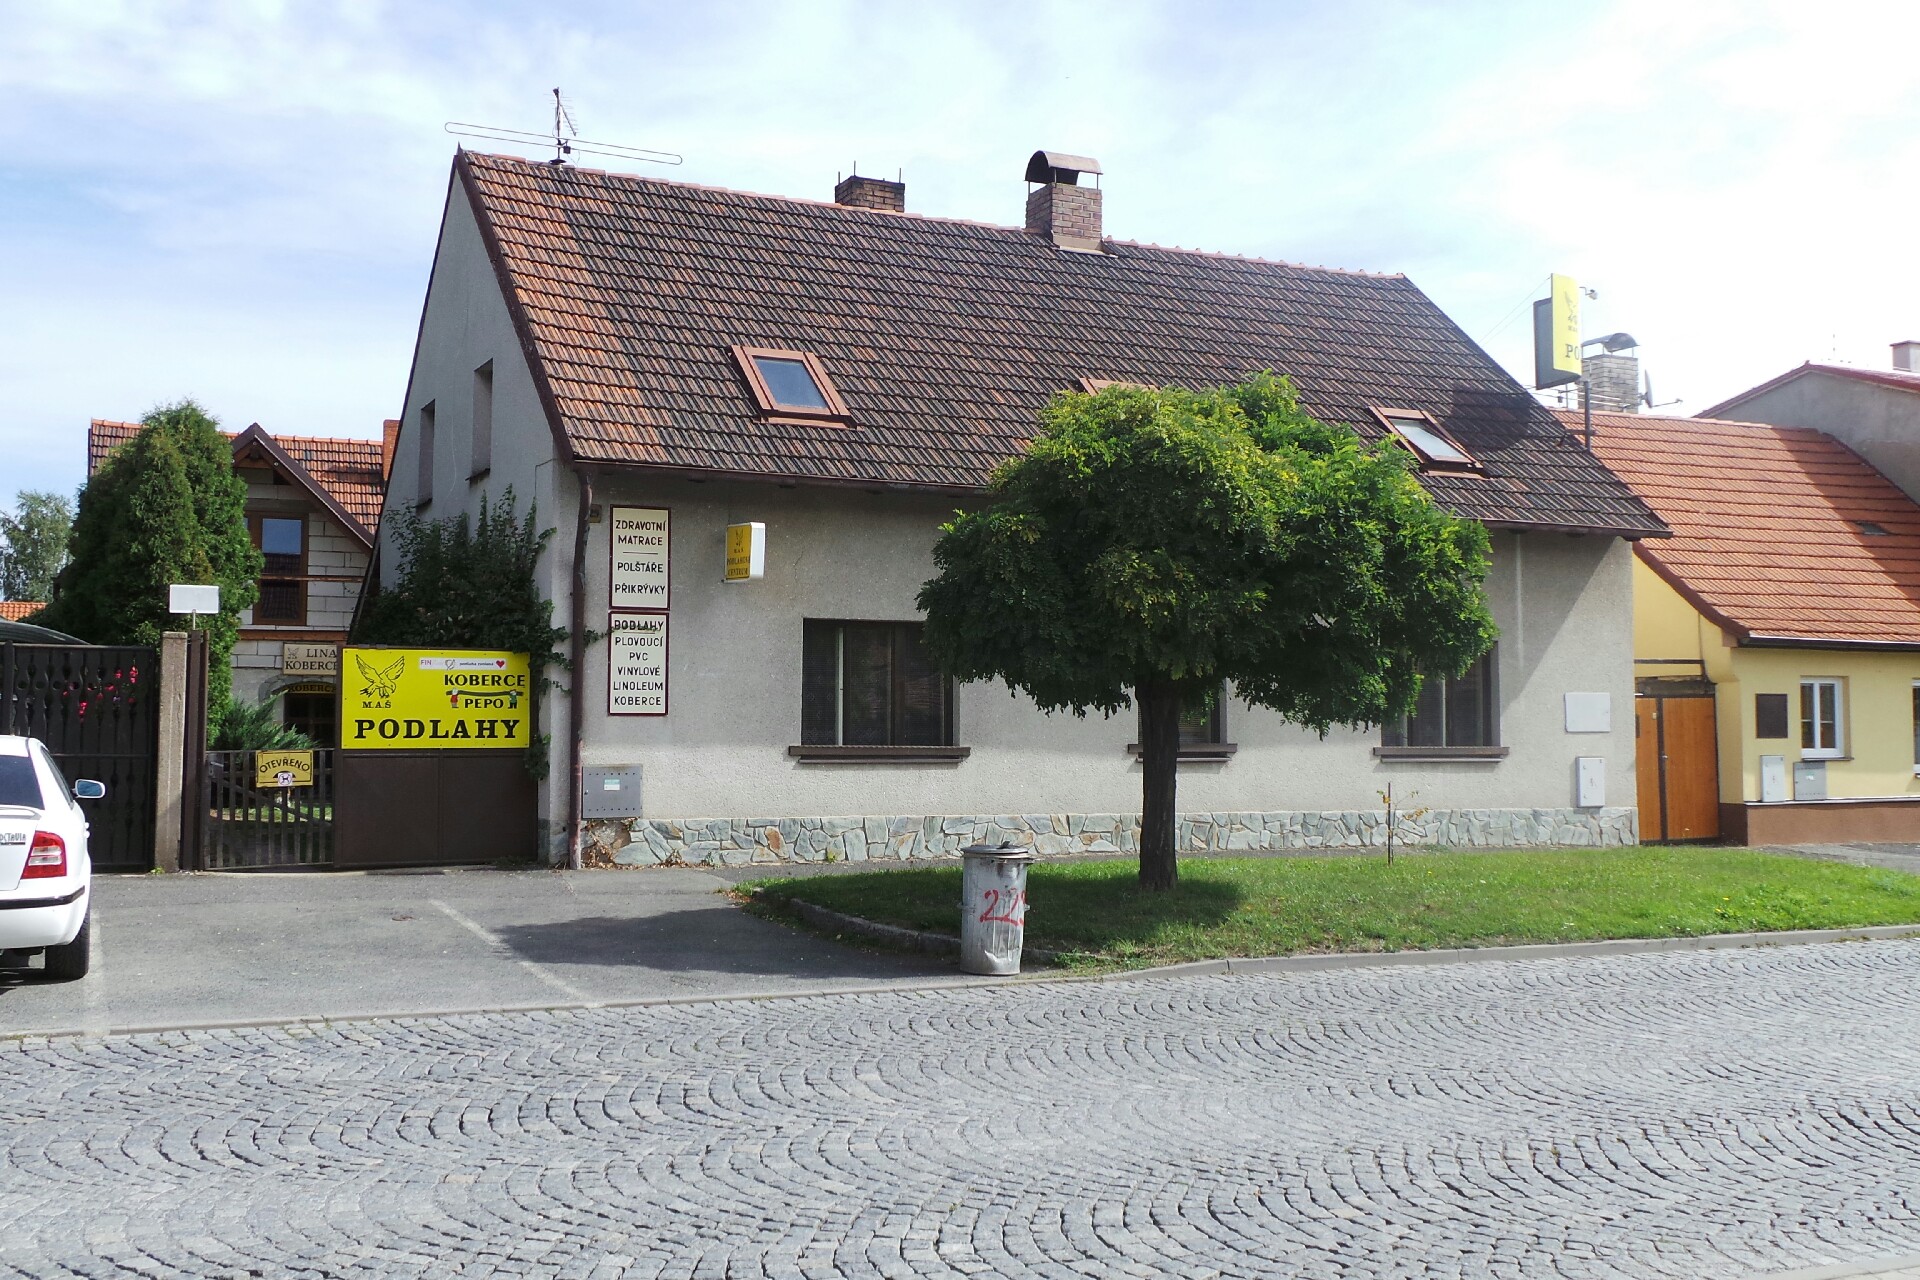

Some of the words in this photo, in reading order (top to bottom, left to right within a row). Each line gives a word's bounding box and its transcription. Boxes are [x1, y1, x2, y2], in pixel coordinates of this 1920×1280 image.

[615, 520, 666, 531] ZDRAVOTNÍ
[618, 535, 663, 546] MATRACE
[617, 561, 663, 573] POLŠTÁŘE
[614, 583, 665, 595] PŘIKRÝVKY
[614, 620, 664, 631] PODLAHY
[615, 636, 663, 647] PLOVOUCÍ
[629, 652, 648, 661] PVC
[617, 665, 660, 676] VINYLOVÉ
[444, 674, 526, 687] KOBERCE
[613, 681, 663, 691] LINOLEUM
[464, 698, 504, 709] PEPO
[614, 696, 661, 706] KOBERCE
[354, 718, 520, 739] PODLAHY
[259, 757, 310, 774] OTEVŘENO
